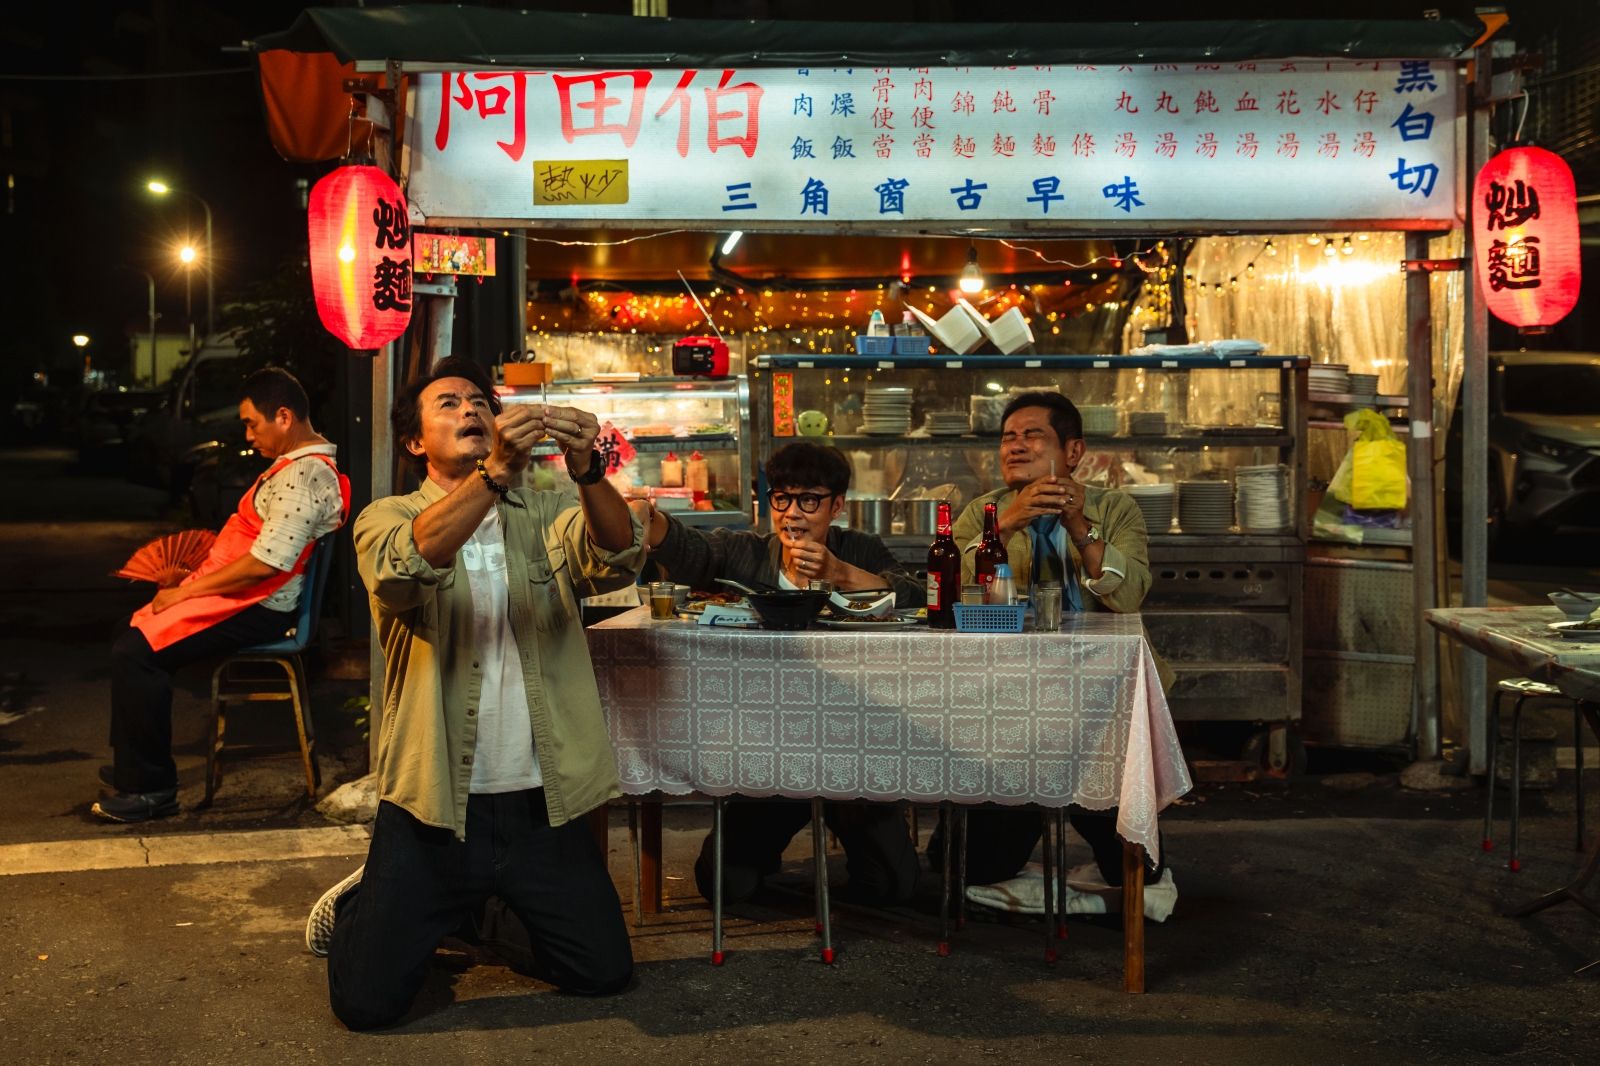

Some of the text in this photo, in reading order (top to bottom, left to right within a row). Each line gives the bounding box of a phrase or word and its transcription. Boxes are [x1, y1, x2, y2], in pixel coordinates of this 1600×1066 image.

[434, 68, 765, 162] 阿田伯
[790, 68, 816, 160] 肉飯
[830, 68, 857, 160] 燥飯
[952, 66, 976, 159] 錦麵
[991, 66, 1017, 157] 飩麵
[1031, 65, 1057, 157] 骨麵
[1114, 64, 1139, 159] 丸湯
[1154, 64, 1180, 159] 丸湯
[1315, 62, 1342, 159] 水湯
[1353, 62, 1380, 158] 仔湯
[1388, 61, 1440, 199] 黑白切
[722, 175, 1147, 215] 三角窗古早味
